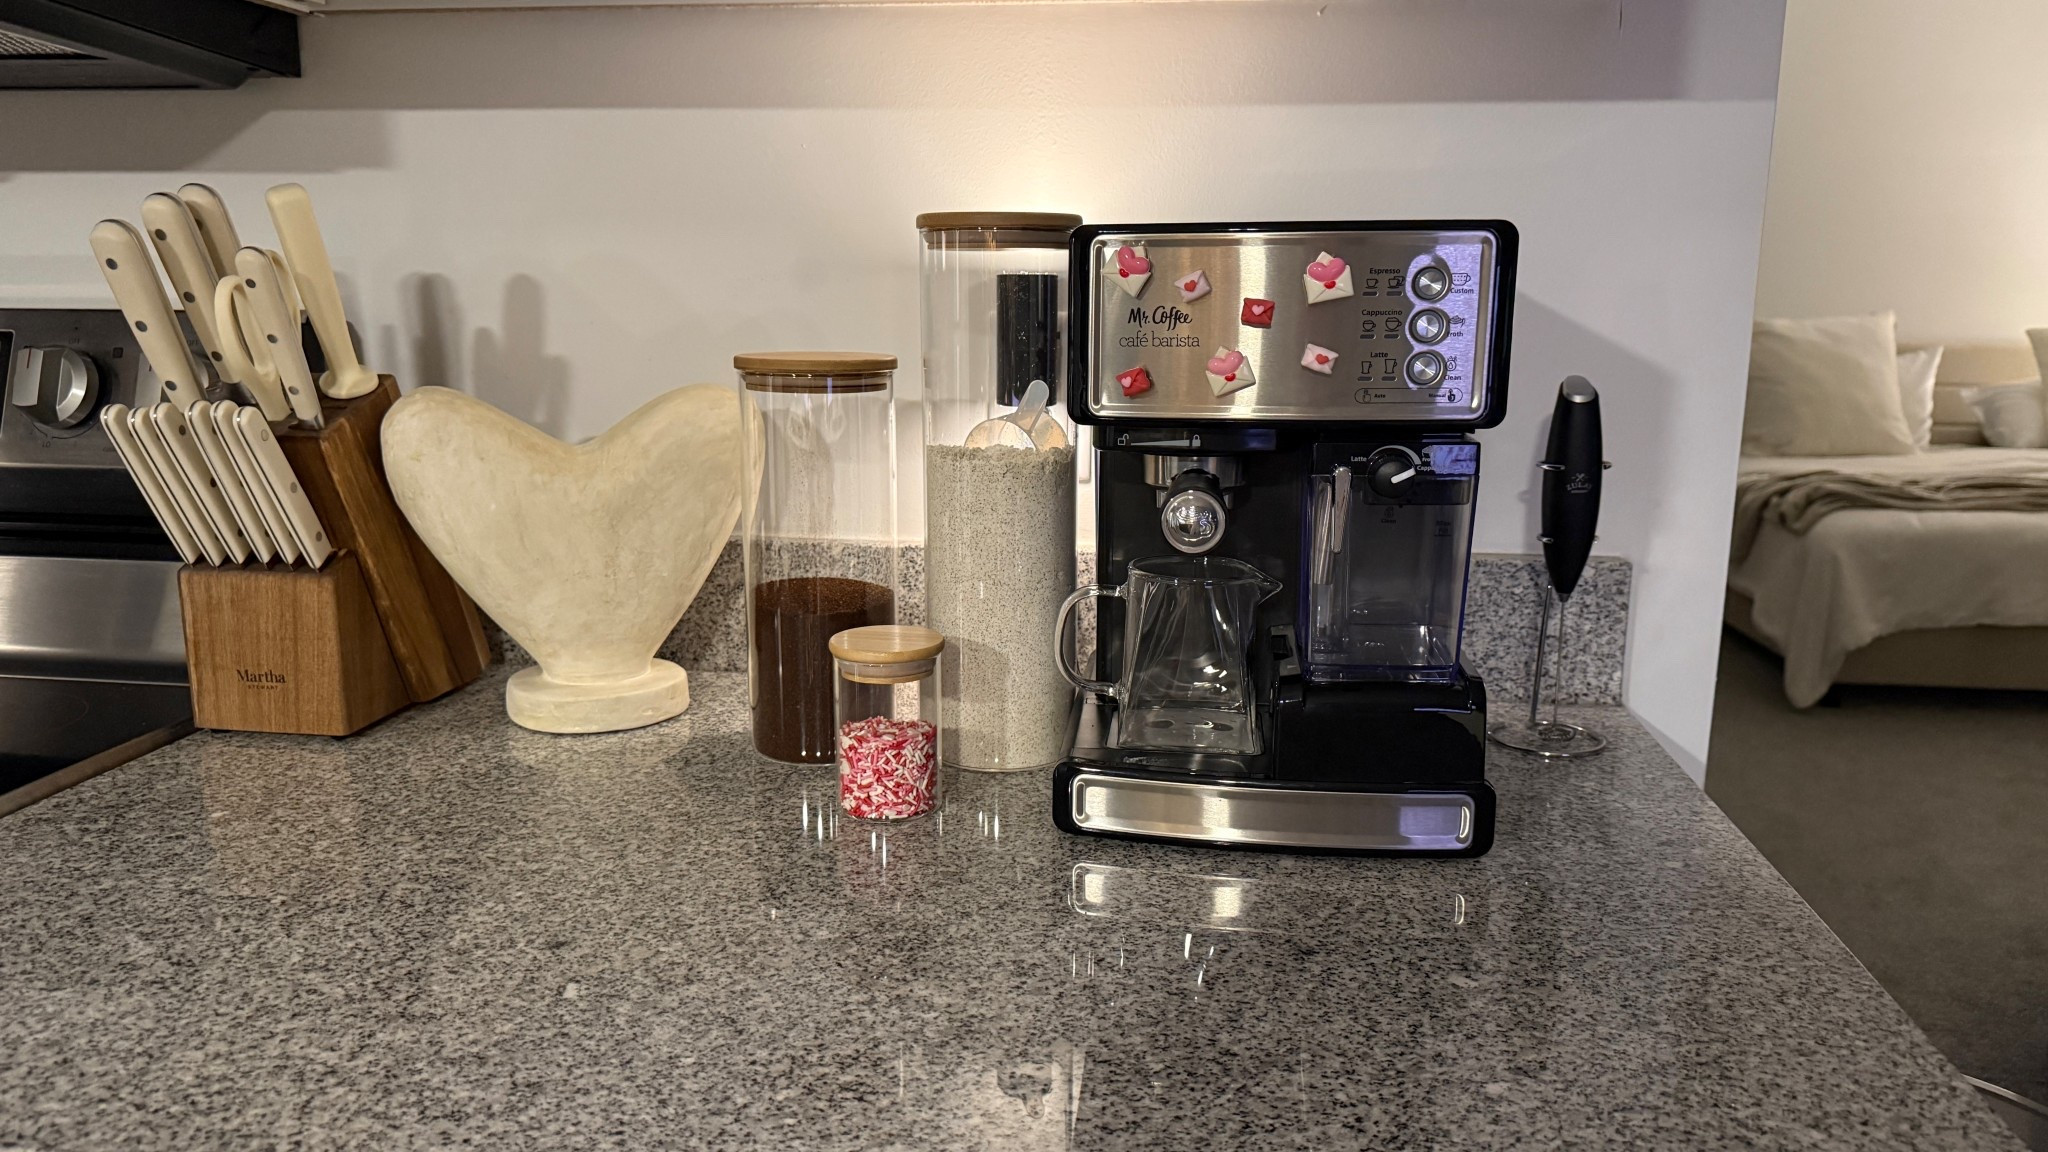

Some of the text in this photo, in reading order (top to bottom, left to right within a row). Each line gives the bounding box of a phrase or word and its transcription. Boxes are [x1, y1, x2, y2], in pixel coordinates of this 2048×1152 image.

[1369, 267, 1401, 275] Espresso
[1450, 287, 1475, 295] Custom
[1128, 305, 1193, 331] Mr. Coffee
[1361, 308, 1403, 317] Cappuccino
[1118, 330, 1200, 347] café barista
[236, 669, 287, 684] Martha
